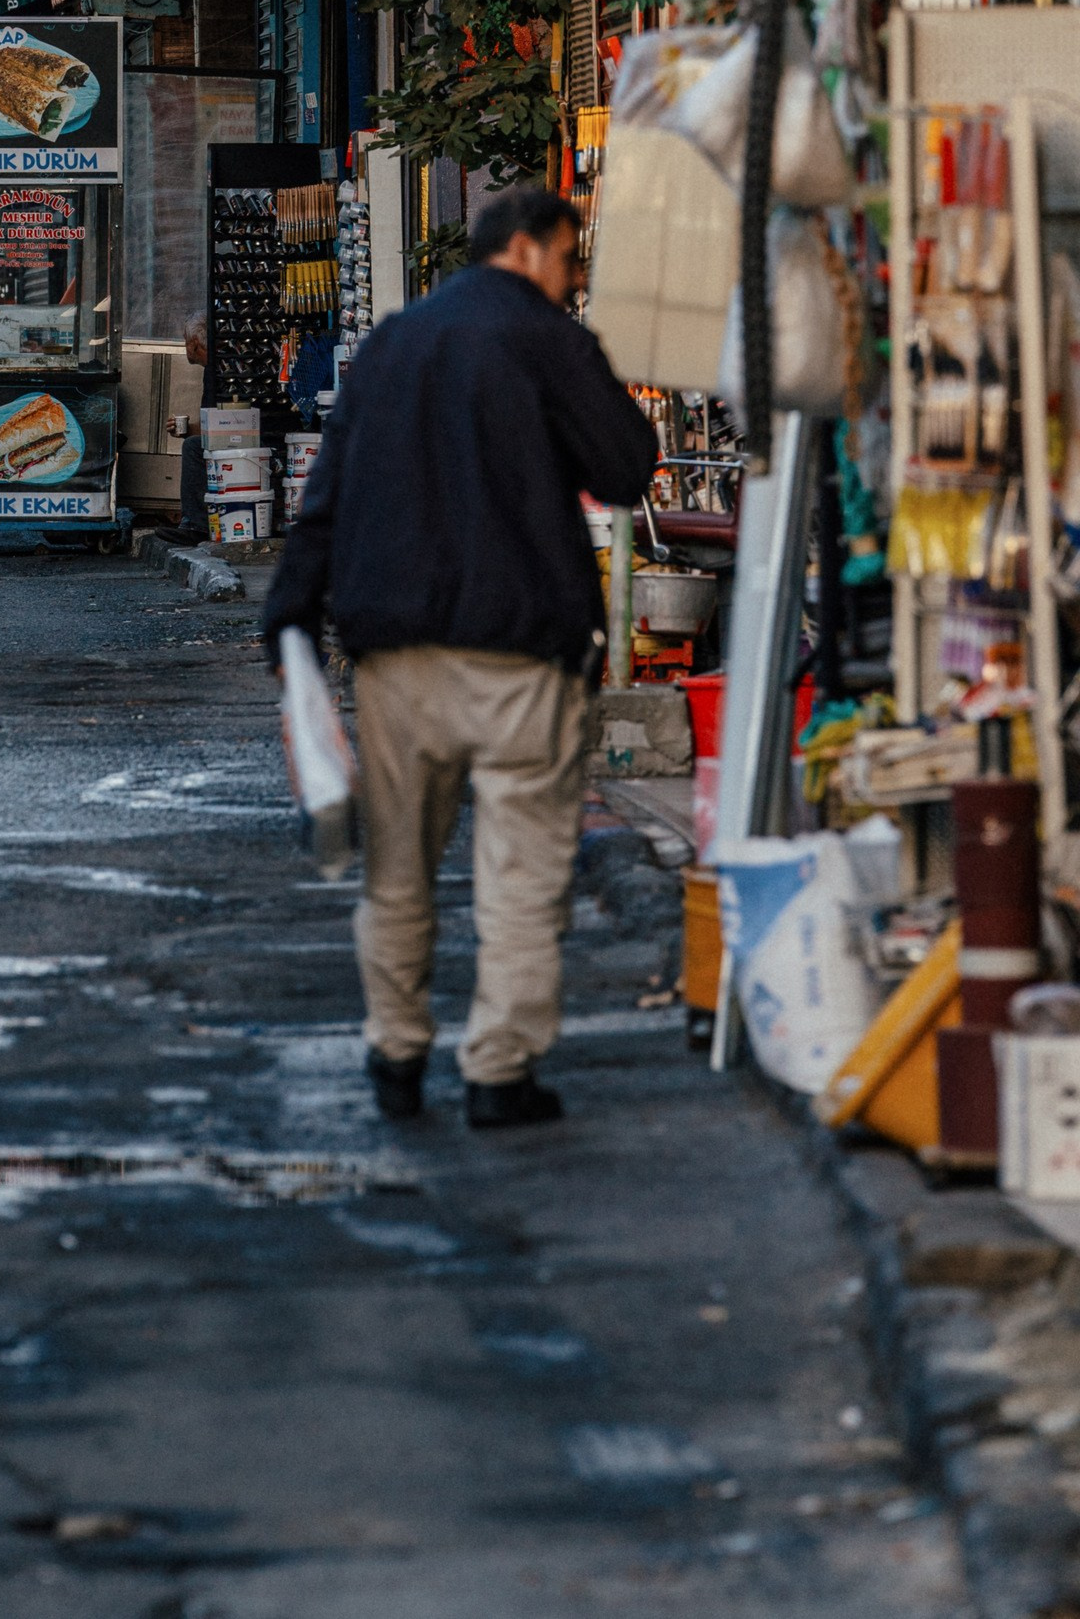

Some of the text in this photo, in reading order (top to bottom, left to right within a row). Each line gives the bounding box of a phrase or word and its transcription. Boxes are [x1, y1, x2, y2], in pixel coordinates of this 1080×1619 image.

[23, 149, 98, 170] DÜRÜM
[2, 212, 53, 224] MEŞHUR
[7, 226, 85, 239] DÜRÜMCÜSÜ
[22, 497, 91, 514] EKMEK
